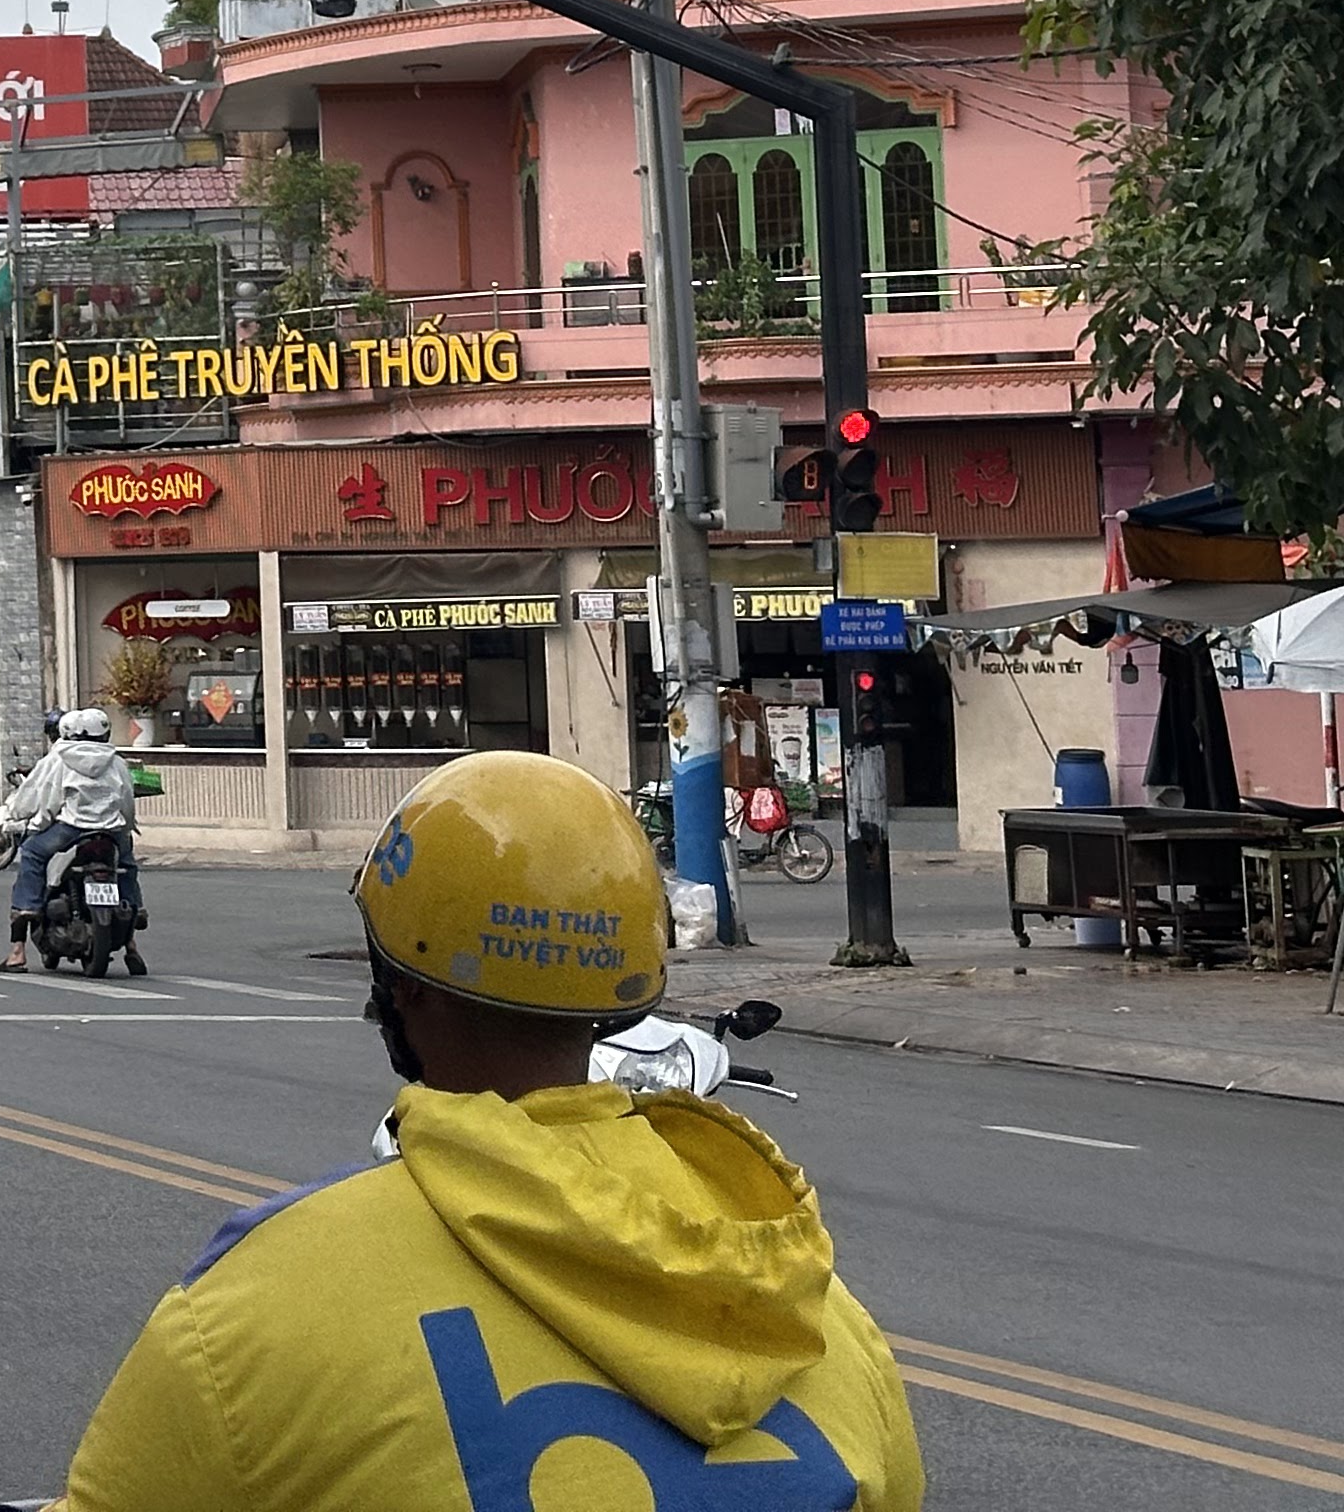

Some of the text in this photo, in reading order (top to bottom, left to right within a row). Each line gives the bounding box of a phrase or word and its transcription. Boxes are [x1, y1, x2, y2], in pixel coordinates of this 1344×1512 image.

[28, 314, 519, 407] CÀ PHÊ TRUYỀN THỐNG
[82, 471, 202, 506] PHƯỚC SANH
[374, 605, 396, 627] CÀ
[504, 602, 557, 625] SANH
[981, 660, 1027, 675] NGUYỄN
[1031, 659, 1055, 675] VĂN
[491, 903, 622, 940] BẠN THẬT
[480, 932, 571, 969] TUYỆT
